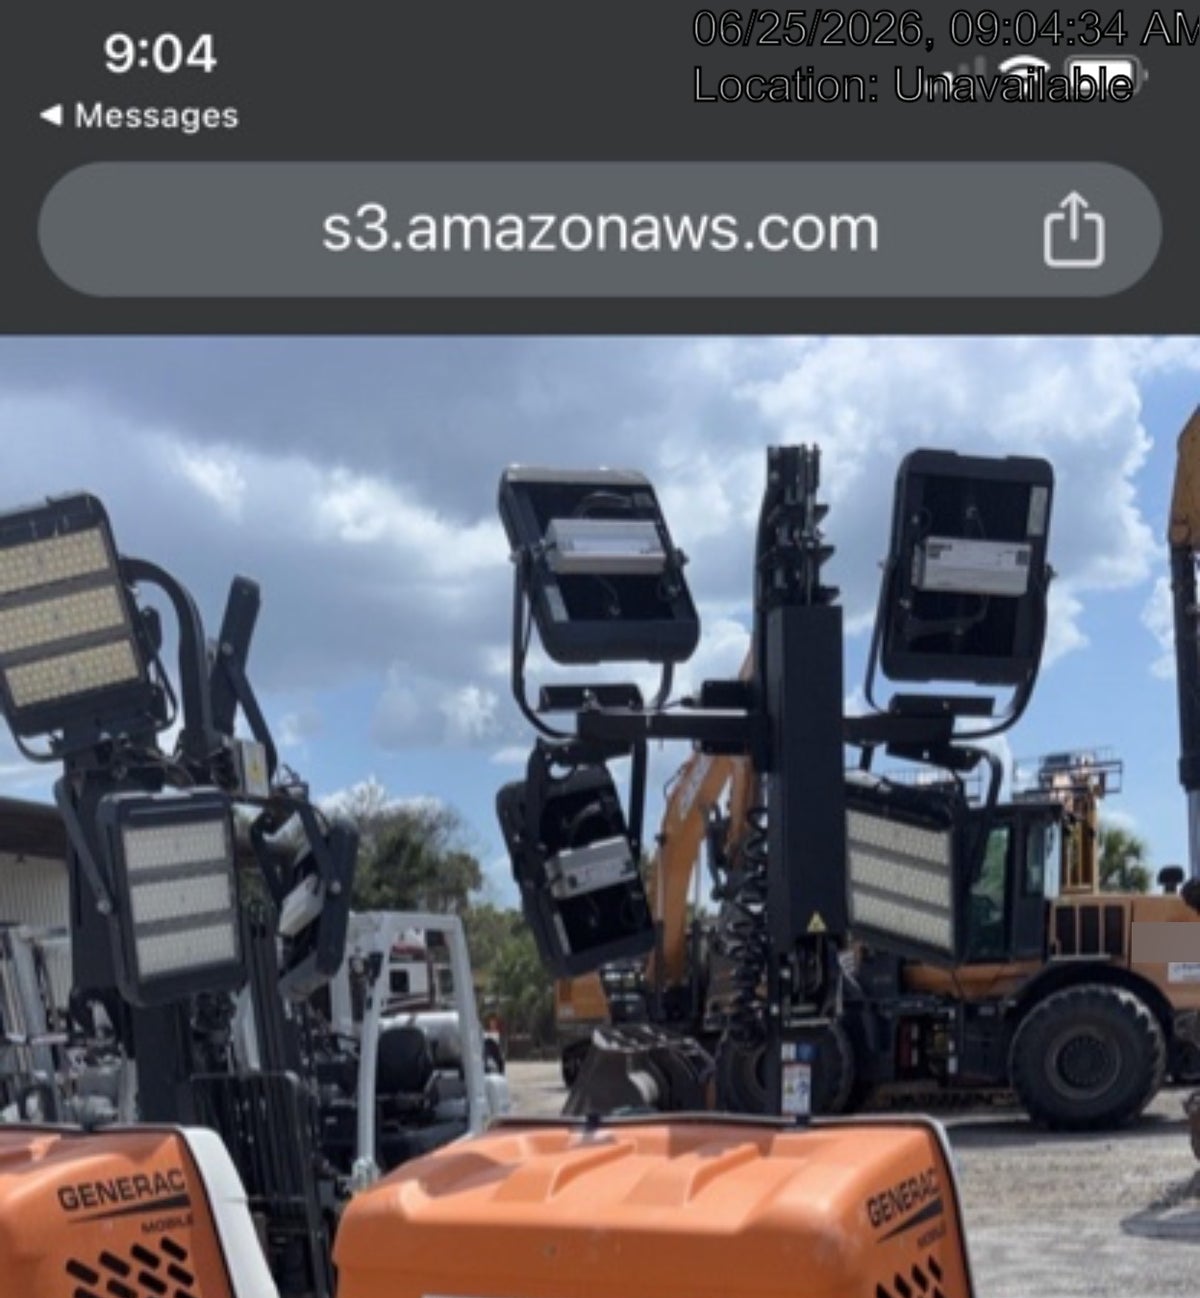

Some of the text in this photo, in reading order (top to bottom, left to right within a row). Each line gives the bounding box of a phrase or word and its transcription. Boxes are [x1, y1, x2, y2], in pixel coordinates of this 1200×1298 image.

[104, 32, 218, 74] 9:04
[74, 101, 240, 135] Messages
[322, 202, 880, 253] s3.amazonaws.com
[57, 1168, 185, 1211] GENERAC
[866, 1167, 940, 1228] GENERAC
